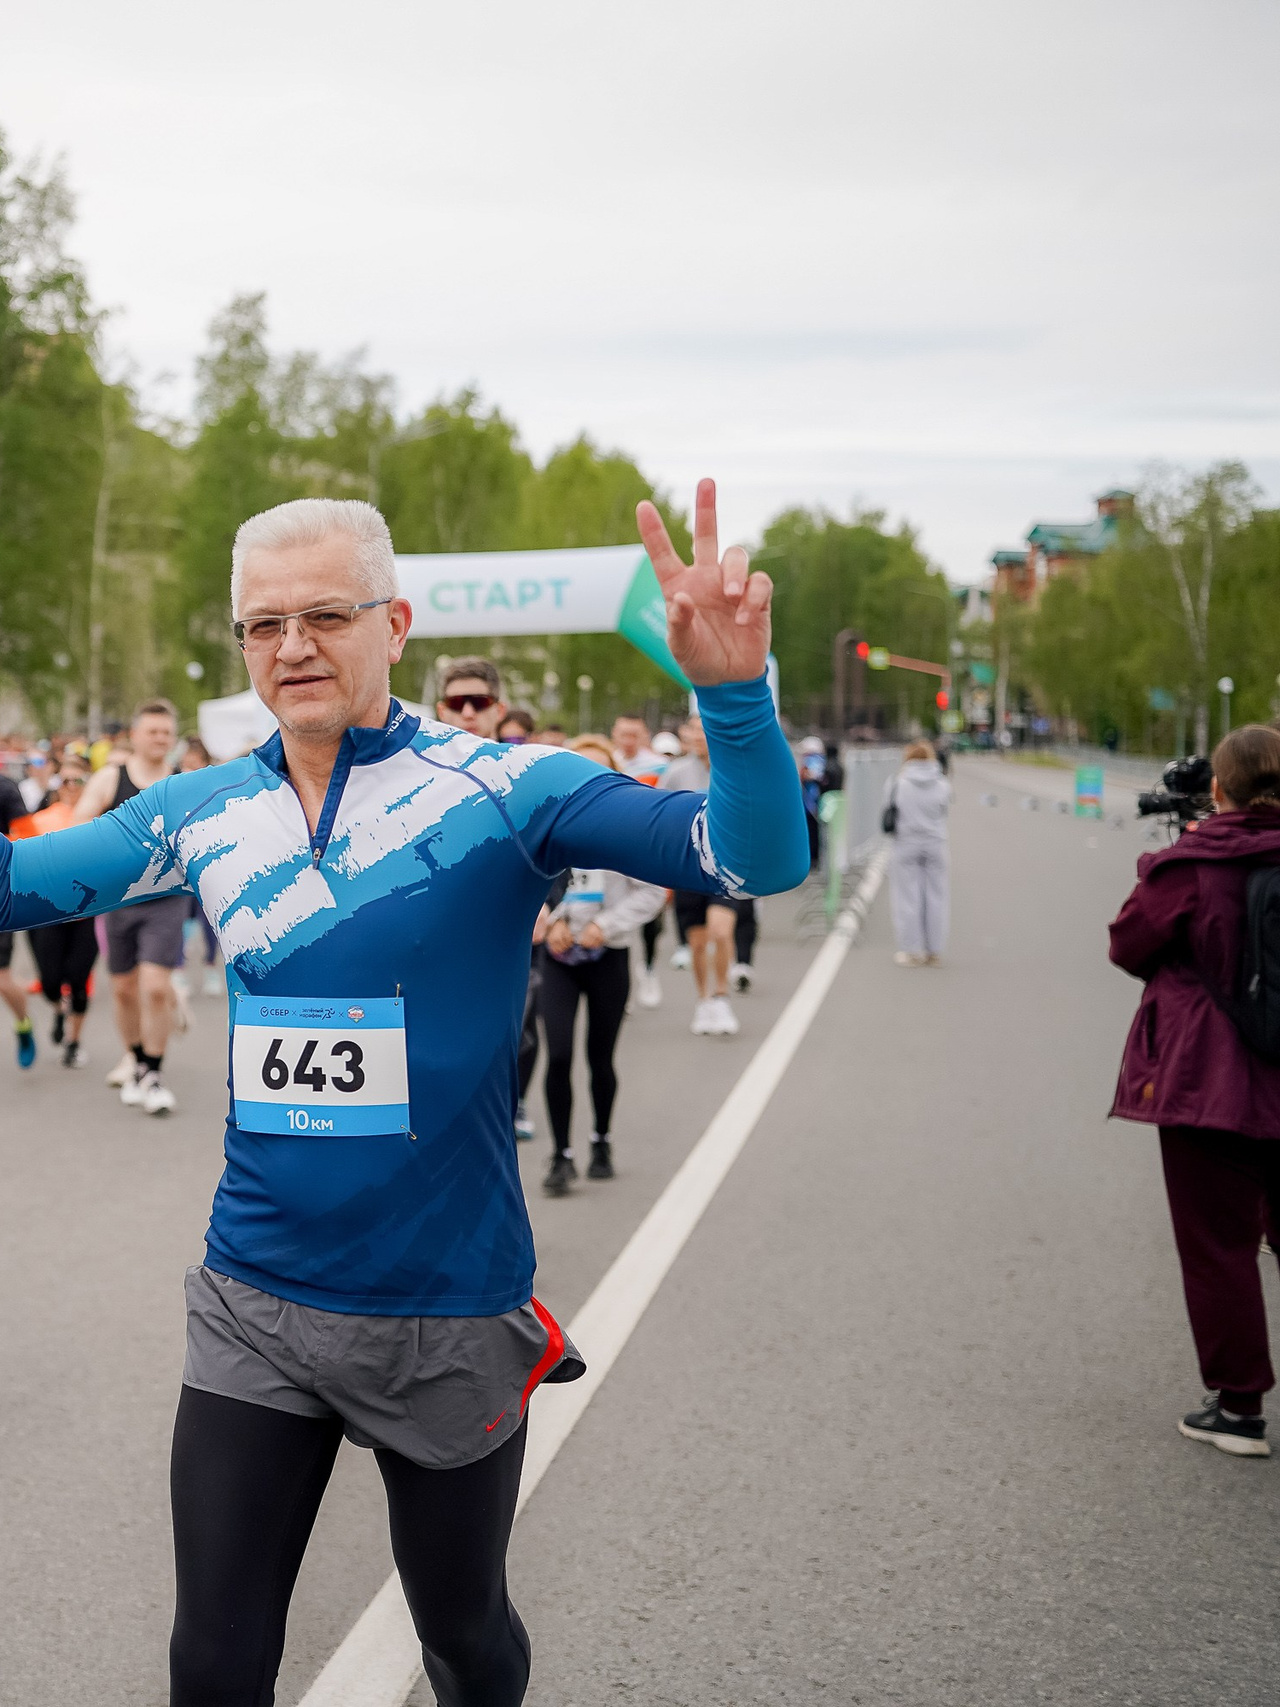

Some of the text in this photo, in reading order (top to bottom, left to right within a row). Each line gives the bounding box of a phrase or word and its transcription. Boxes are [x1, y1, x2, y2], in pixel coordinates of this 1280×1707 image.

[428, 578, 571, 613] СТАРТ
[270, 1009, 289, 1017] СБЕР
[261, 1038, 366, 1093] 643
